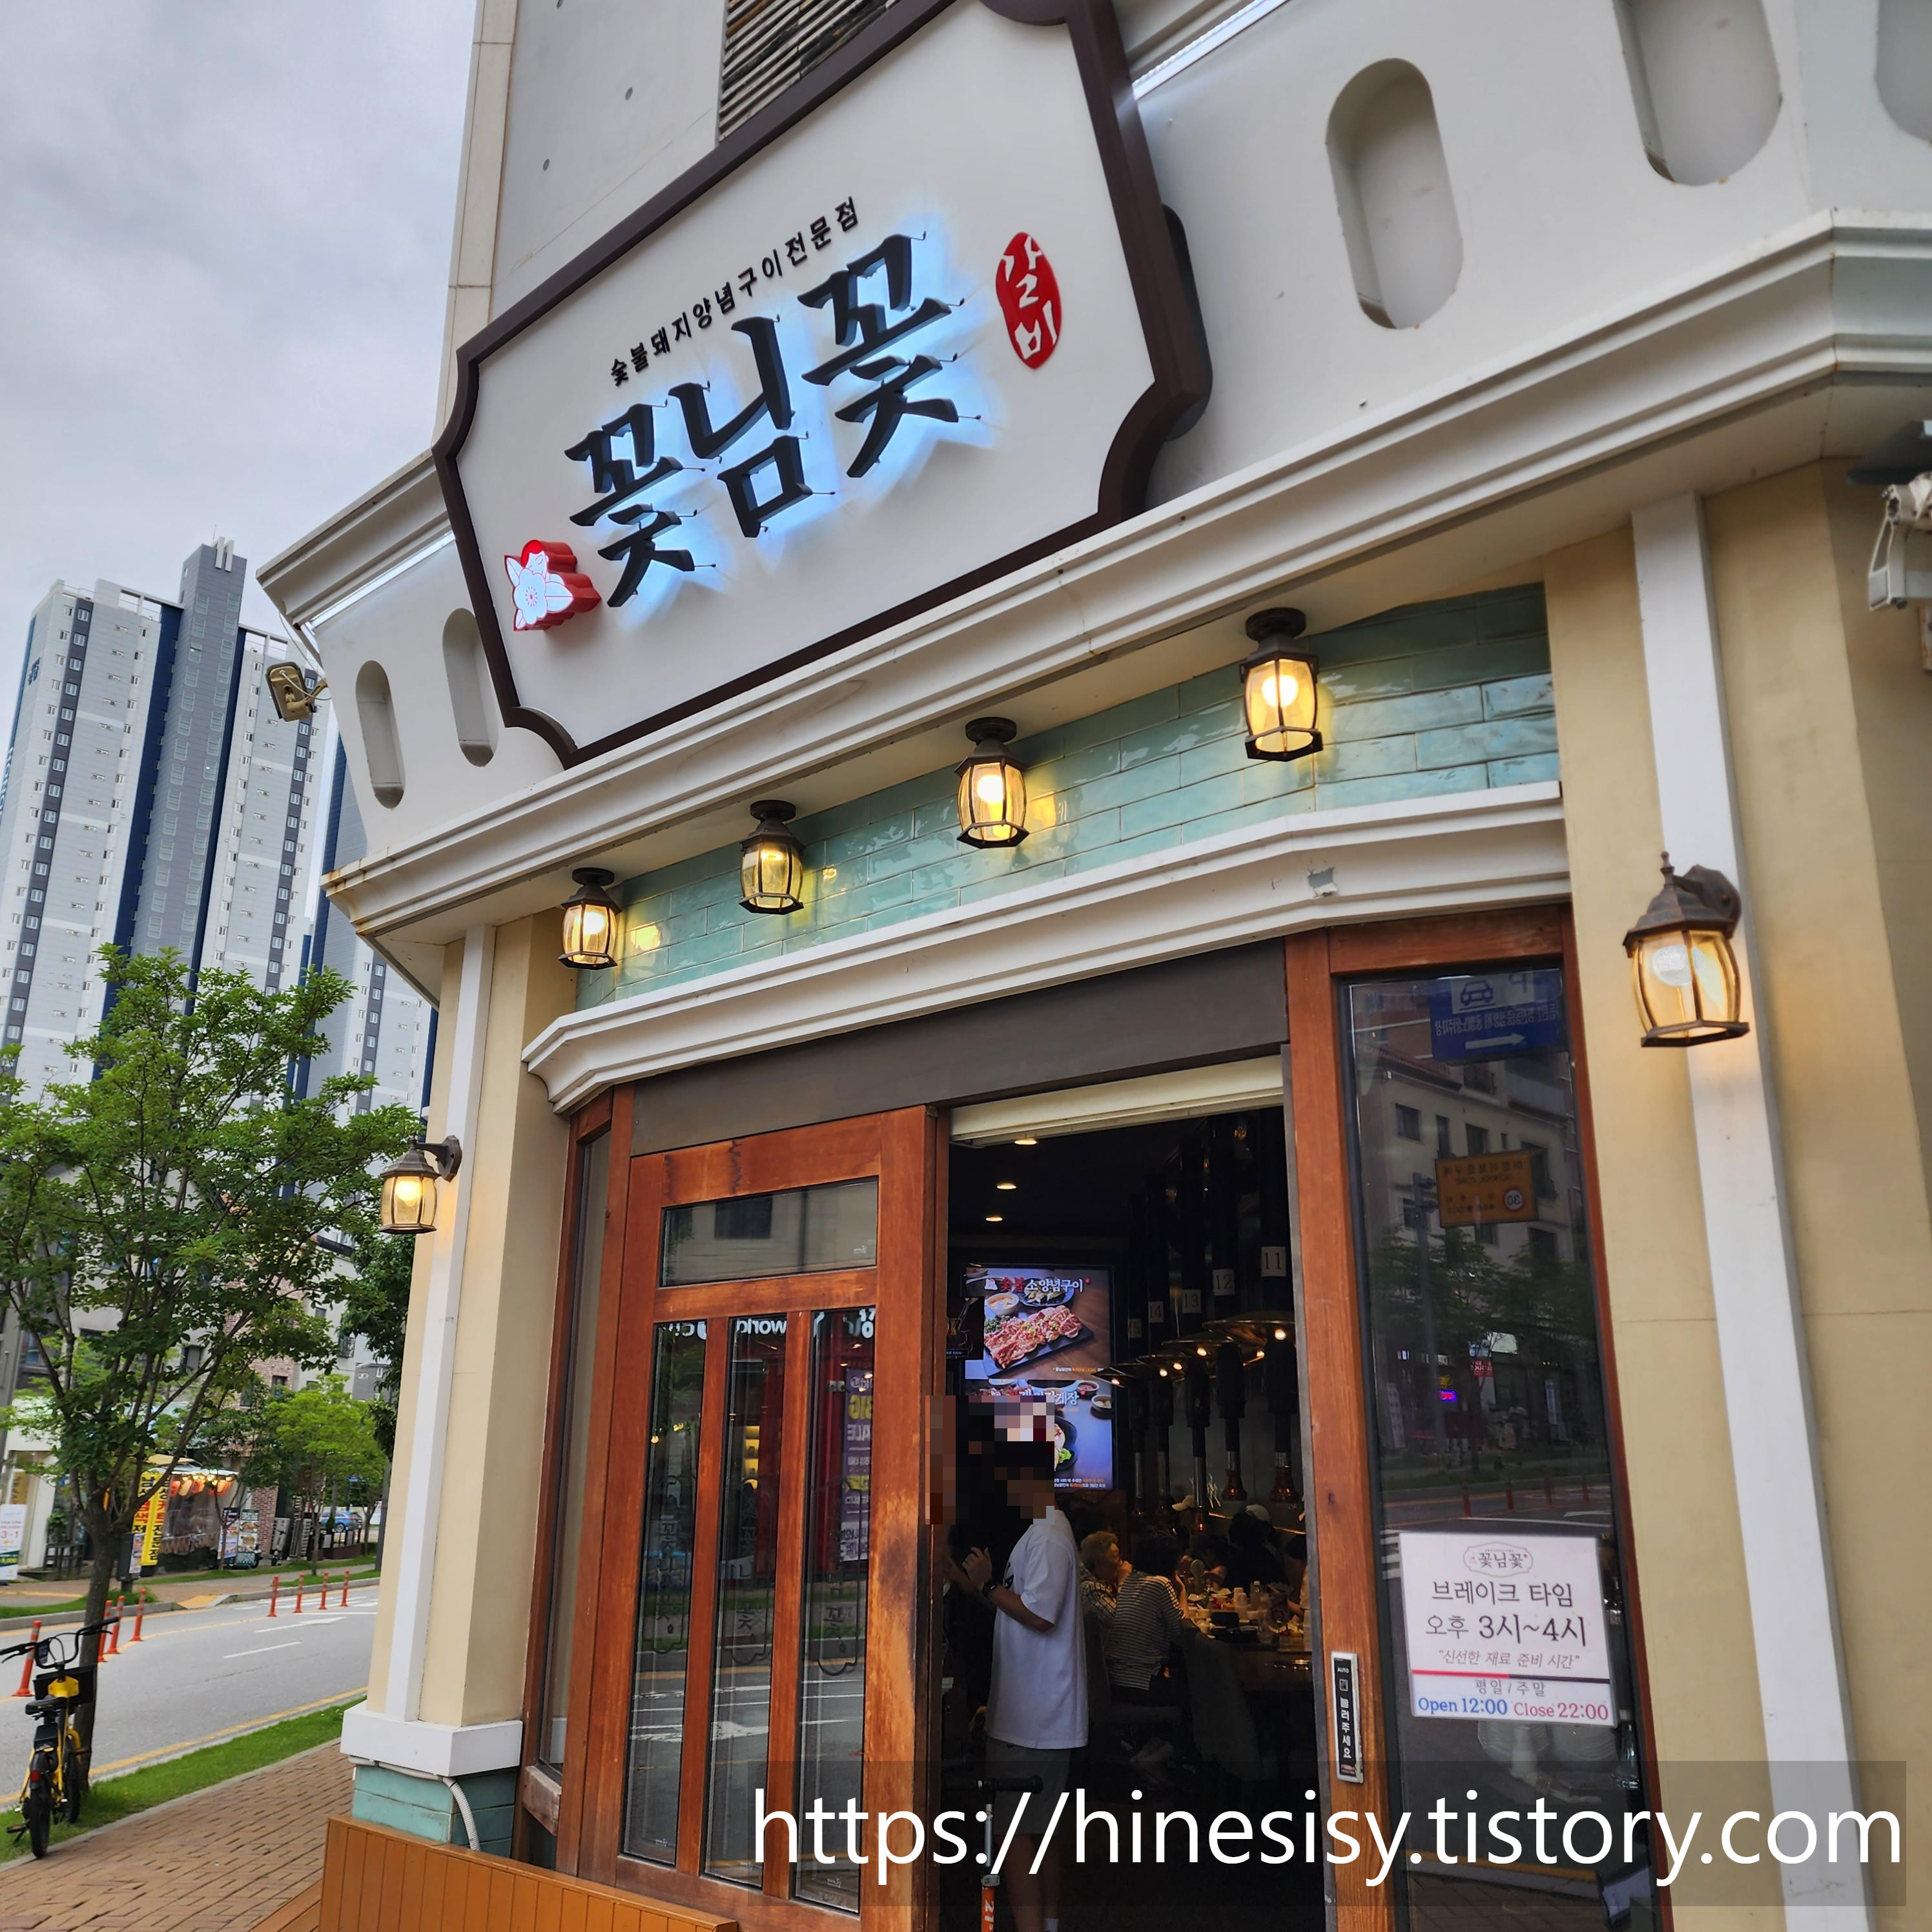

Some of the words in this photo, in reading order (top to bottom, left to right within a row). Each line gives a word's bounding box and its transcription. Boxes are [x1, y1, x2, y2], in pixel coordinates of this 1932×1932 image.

[610, 196, 859, 386] 숯불돼지양념구이전문점
[564, 233, 961, 608] 꽃님꽃
[1264, 1252, 1282, 1270] 11
[1215, 1274, 1233, 1290] 12
[1184, 1293, 1199, 1308] 13
[1478, 1552, 1524, 1568] 꽃님꽃
[1432, 1581, 1520, 1607] 브레이크
[1529, 1583, 1574, 1608] 타임
[1425, 1614, 1469, 1639] 오후
[1479, 1614, 1587, 1646] 3시~4시
[1485, 1651, 1511, 1667] 재료
[1517, 1652, 1543, 1669] 준비
[1418, 1696, 1459, 1714] Open
[1461, 1697, 1508, 1715] 12:00
[1514, 1700, 1555, 1718] Close
[1557, 1703, 1608, 1721] 22:00
